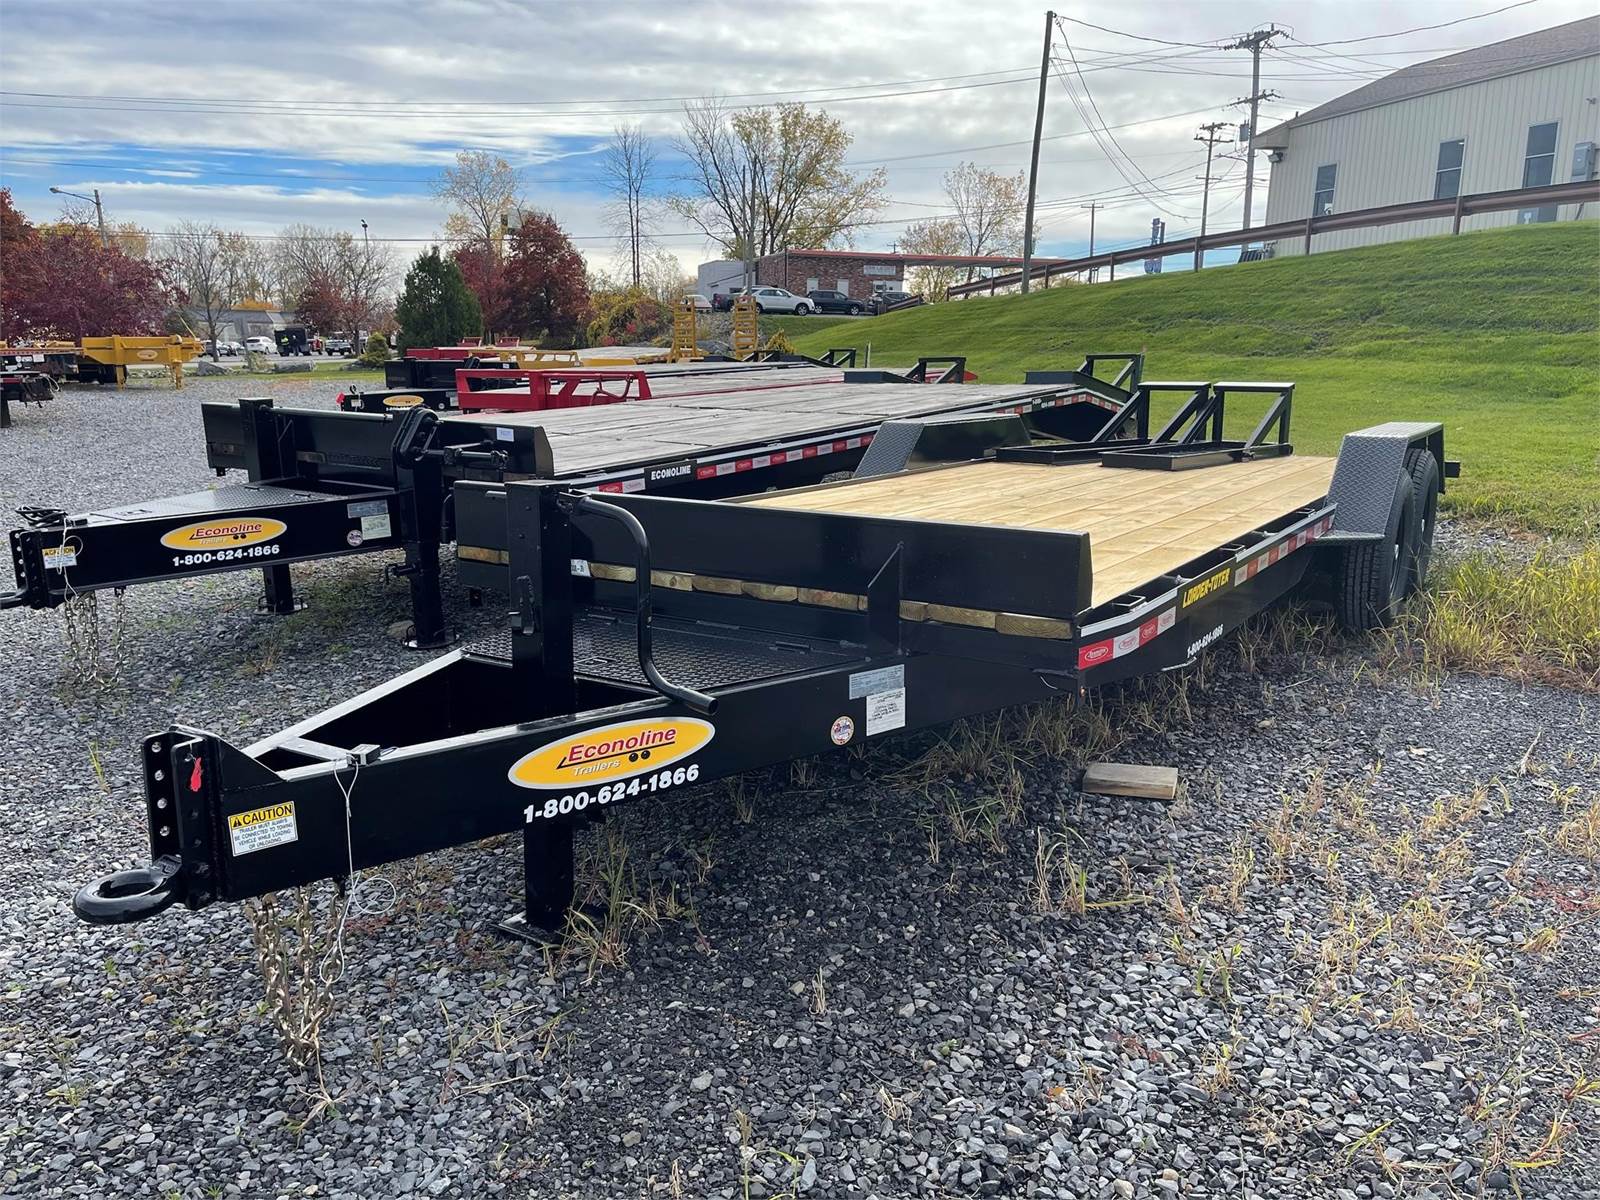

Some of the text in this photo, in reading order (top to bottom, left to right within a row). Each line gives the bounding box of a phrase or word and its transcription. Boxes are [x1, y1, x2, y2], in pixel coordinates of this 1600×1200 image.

[651, 465, 692, 480] ECONOLINE
[195, 523, 262, 537] Econoline
[172, 544, 280, 567] 1-800-624-1866
[568, 728, 677, 762] Econoline
[573, 758, 621, 777] Trailers
[523, 763, 700, 824] 1-800-624-1866
[242, 804, 293, 825] CAUTION
[241, 828, 269, 840] CONNECTED
